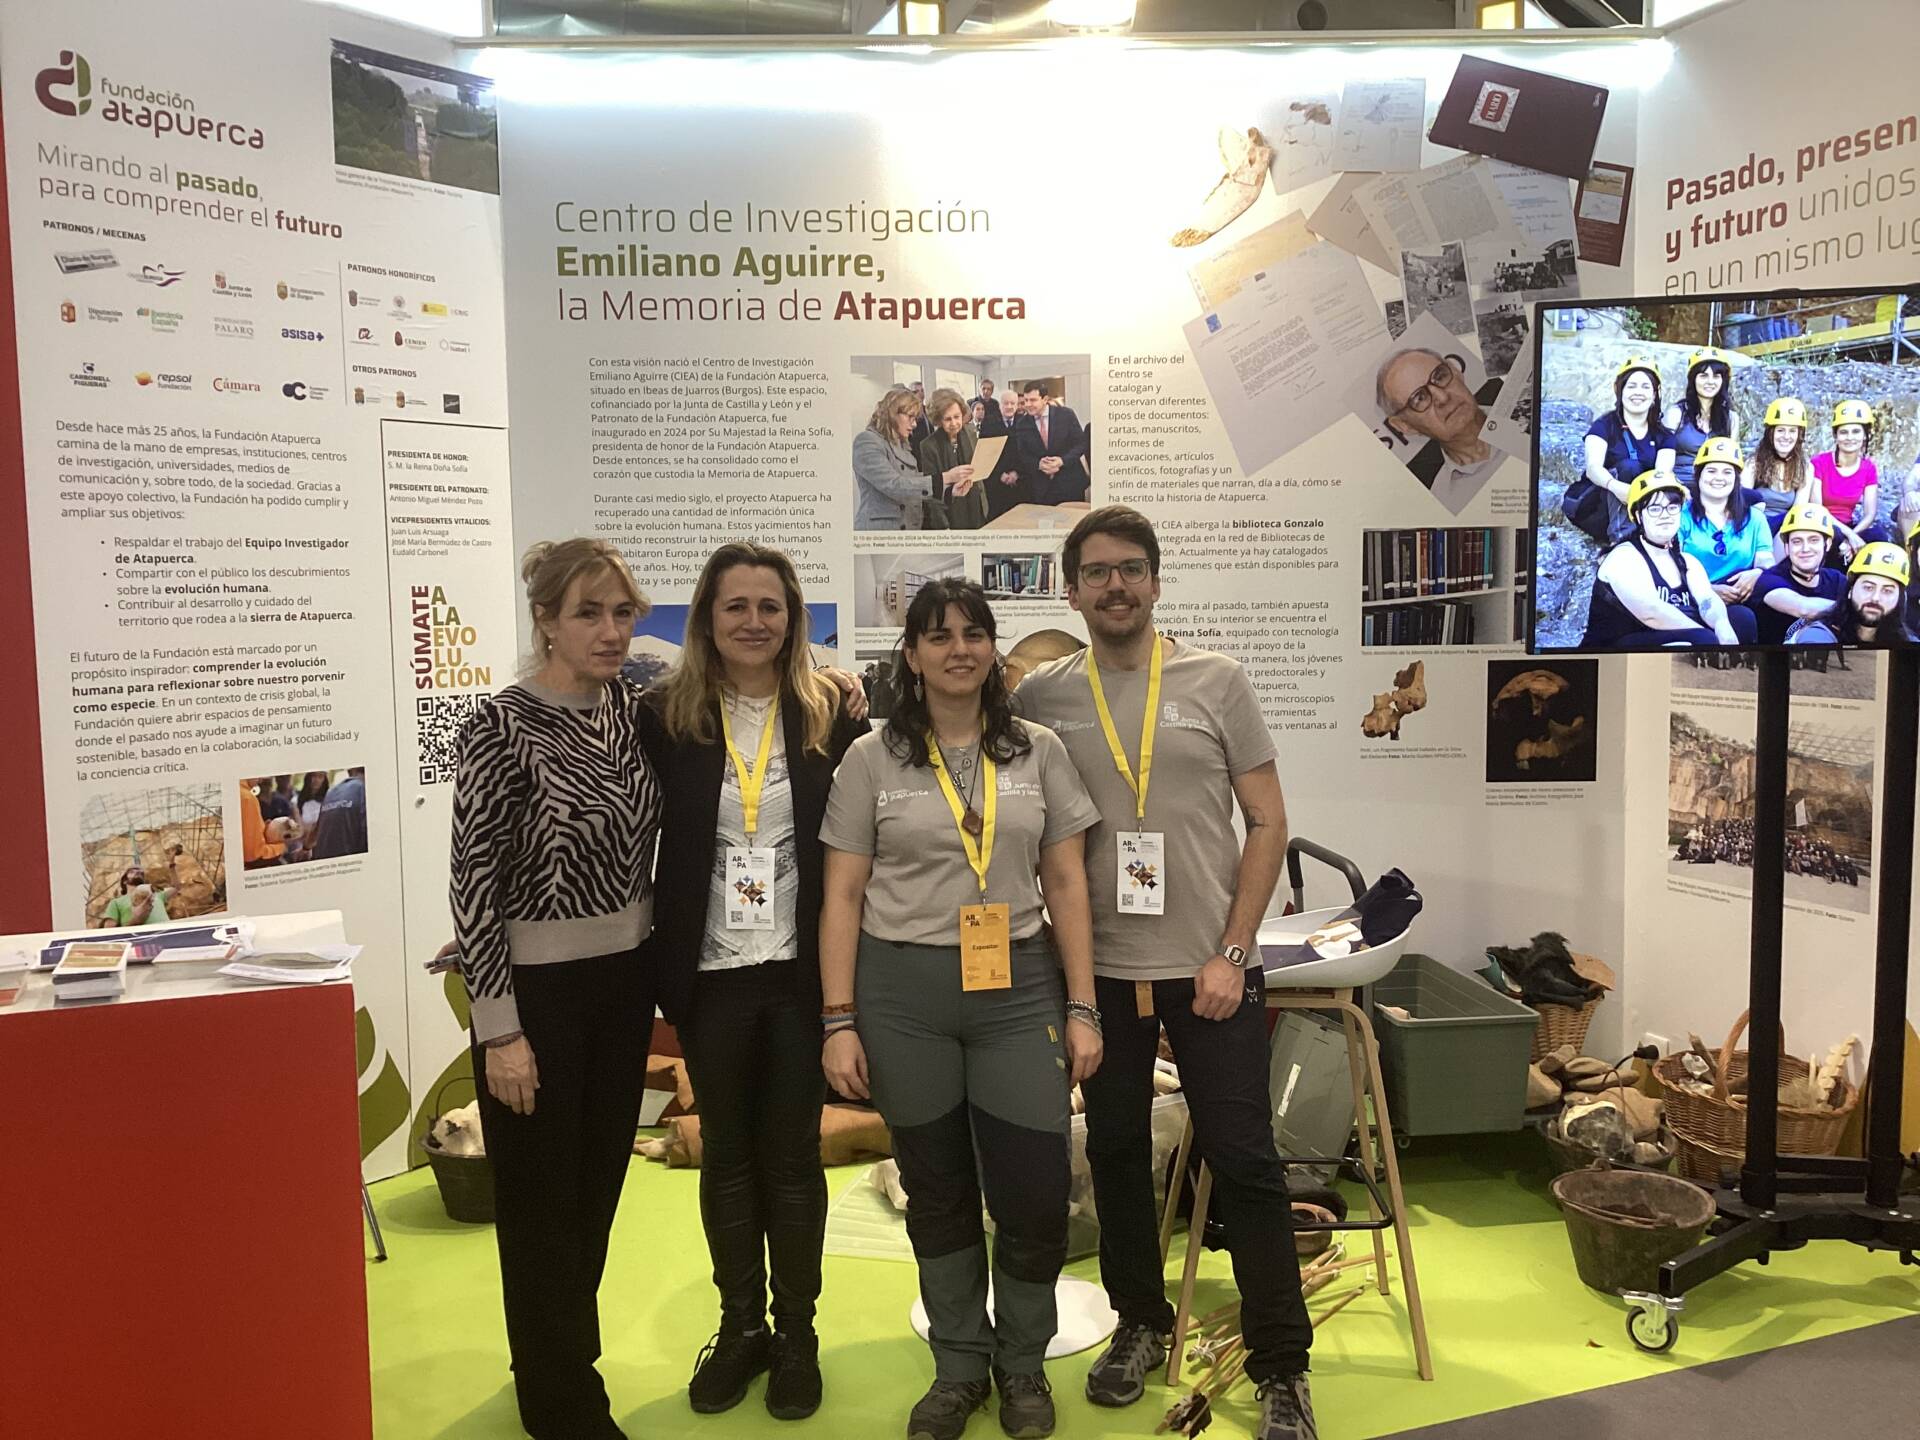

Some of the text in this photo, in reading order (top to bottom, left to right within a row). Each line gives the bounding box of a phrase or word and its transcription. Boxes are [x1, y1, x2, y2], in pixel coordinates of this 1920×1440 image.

[101, 79, 194, 110] fundación
[102, 101, 263, 147] atapuerca
[38, 144, 262, 200] Mirando al pasado,
[1667, 153, 1784, 210] Pasado,
[39, 178, 341, 237] para comprender el futuro
[1666, 168, 1915, 263] y futuro unidos
[556, 200, 988, 240] Centro de Investigación
[43, 220, 93, 233] PATRONOS
[102, 228, 145, 240] MECENAS
[347, 264, 435, 281] PATRONOS HONORÍFICOS
[557, 245, 884, 283] Emiliano Aguirre,
[1665, 270, 1697, 296] en
[1709, 260, 1742, 289] un
[1756, 232, 1863, 279] mismo
[559, 288, 1024, 326] la Memoria de Atapuerca
[589, 358, 608, 366] Con
[633, 358, 660, 366] visión
[664, 358, 688, 366] nació
[692, 357, 700, 366] el
[702, 358, 734, 366] Centro
[737, 358, 748, 366] de
[752, 358, 813, 367] Investigación
[1108, 355, 1184, 364] En el archivo del
[158, 373, 192, 383] repsol
[378, 368, 416, 376] PATRONOS
[589, 371, 828, 382] Emiliano Aguirre (CIEA) de la Fundación Atapuerca,
[1108, 369, 1139, 378] Centro
[213, 376, 261, 392] Cámara
[1108, 384, 1161, 394] catalogan y
[1108, 412, 1131, 421] tipos
[1133, 411, 1145, 419] de
[56, 420, 320, 444] Desde hace más 25 años, la Fundación Atapuerca
[1108, 438, 1164, 447] informes de
[1174, 452, 1213, 460] artículos
[417, 496, 439, 504] Miguel
[656, 494, 685, 502] medio
[688, 494, 712, 504] siglo,
[715, 493, 723, 501] el
[726, 495, 766, 504] proyecto
[769, 494, 816, 502] Atapuerca
[820, 492, 831, 501] ha
[422, 528, 448, 537] Arsuaga
[1185, 521, 1218, 530] alberga
[114, 537, 348, 549] Respaldar el trabajo del Equipo Investigador
[115, 553, 195, 564] de Atapuerca.
[117, 584, 270, 594] sobre la evolución humana.
[431, 586, 447, 605] A
[433, 607, 461, 625] LA
[410, 586, 433, 690] SÚMATE
[434, 626, 476, 646] EVO
[1167, 628, 1194, 638] Reina
[1197, 628, 1222, 636] Sofía,
[1226, 629, 1269, 637] equipado
[1291, 628, 1338, 637] tecnología
[434, 648, 462, 667] LU
[71, 657, 326, 681] propósito inspirador: comprender la evolución
[435, 662, 491, 688] CIÓN
